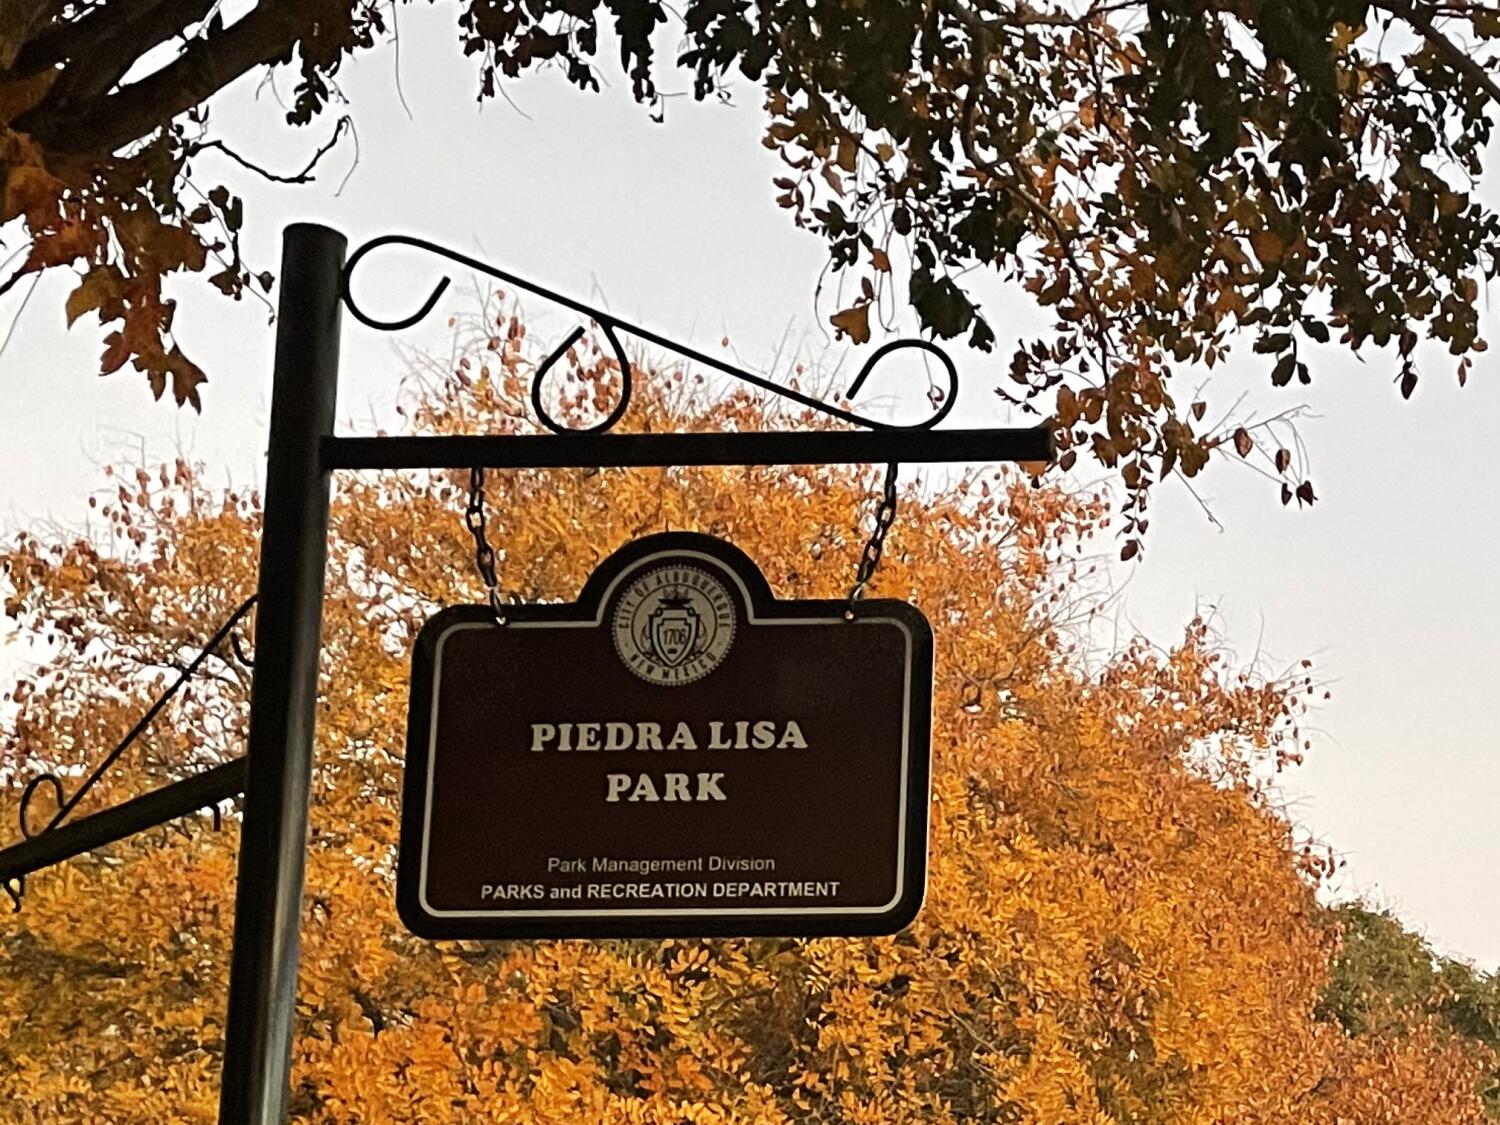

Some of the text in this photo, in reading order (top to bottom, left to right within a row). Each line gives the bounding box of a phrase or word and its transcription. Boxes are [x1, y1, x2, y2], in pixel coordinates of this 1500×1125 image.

[618, 570, 731, 629] CITY OF ALBUQUERQUE
[662, 627, 687, 646] 1706
[629, 653, 656, 675] NEW
[530, 720, 809, 753] PIEDRA LISA
[605, 772, 727, 803] PARK
[547, 855, 775, 875] Park Management Division
[480, 881, 841, 900] PARKS and RECREATION DEPARTMENT
